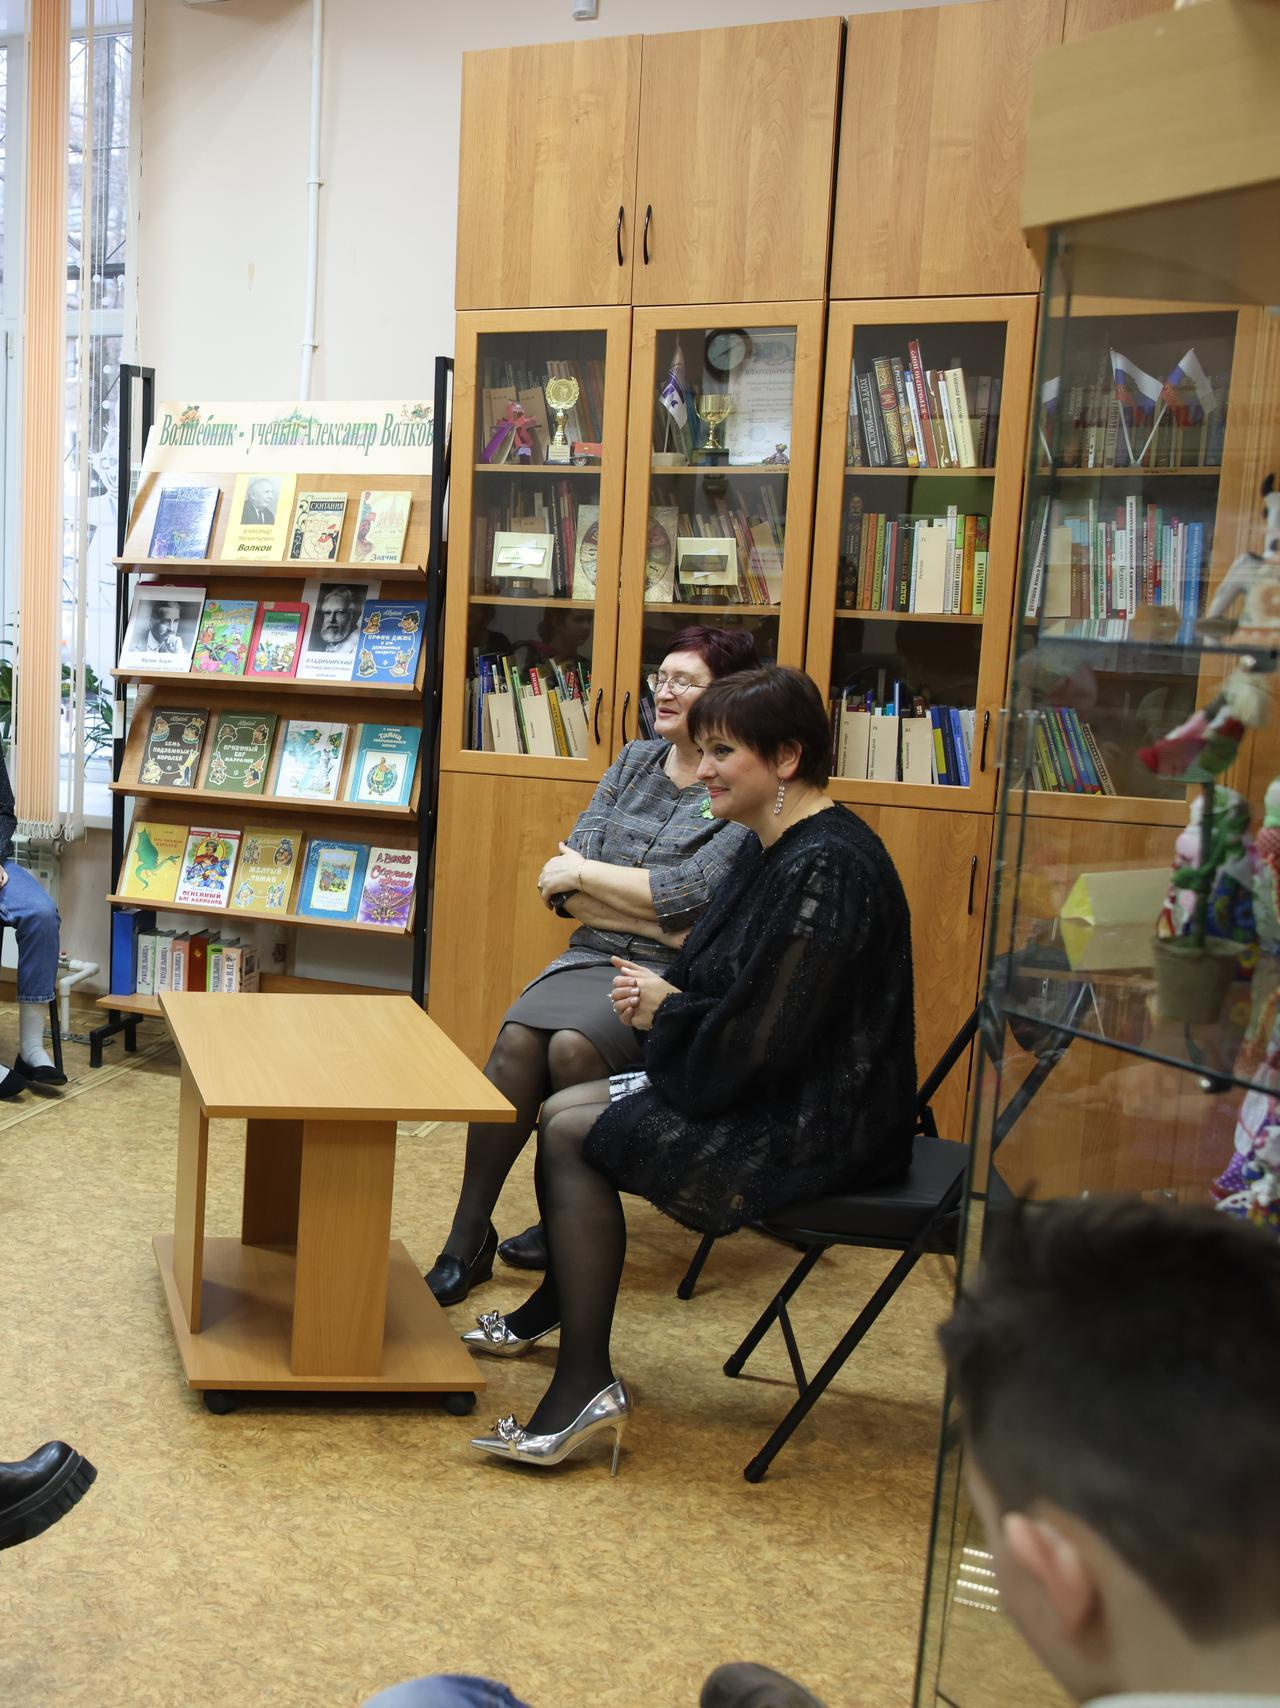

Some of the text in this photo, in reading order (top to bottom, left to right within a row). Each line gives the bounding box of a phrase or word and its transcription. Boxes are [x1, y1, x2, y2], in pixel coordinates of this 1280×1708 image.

[159, 414, 237, 447] Волшебник
[246, 420, 301, 455] ученый
[300, 415, 378, 456] Александр
[380, 413, 433, 447] Волков
[865, 419, 877, 447] ИСТОРИЯ
[310, 502, 344, 510] СКИТАНИЯ
[237, 543, 273, 552] Волков
[976, 563, 985, 605] КУЛЬТУРОЛОГИЯ
[182, 890, 222, 899] ОГНЕННЫЙ
[141, 945, 150, 984] РУКОДЕЛЬНИЦА
[160, 947, 169, 985] РУКОДЕЛЬНИЦА
[174, 953, 183, 991] РУКОДЕЛЬНИЦА
